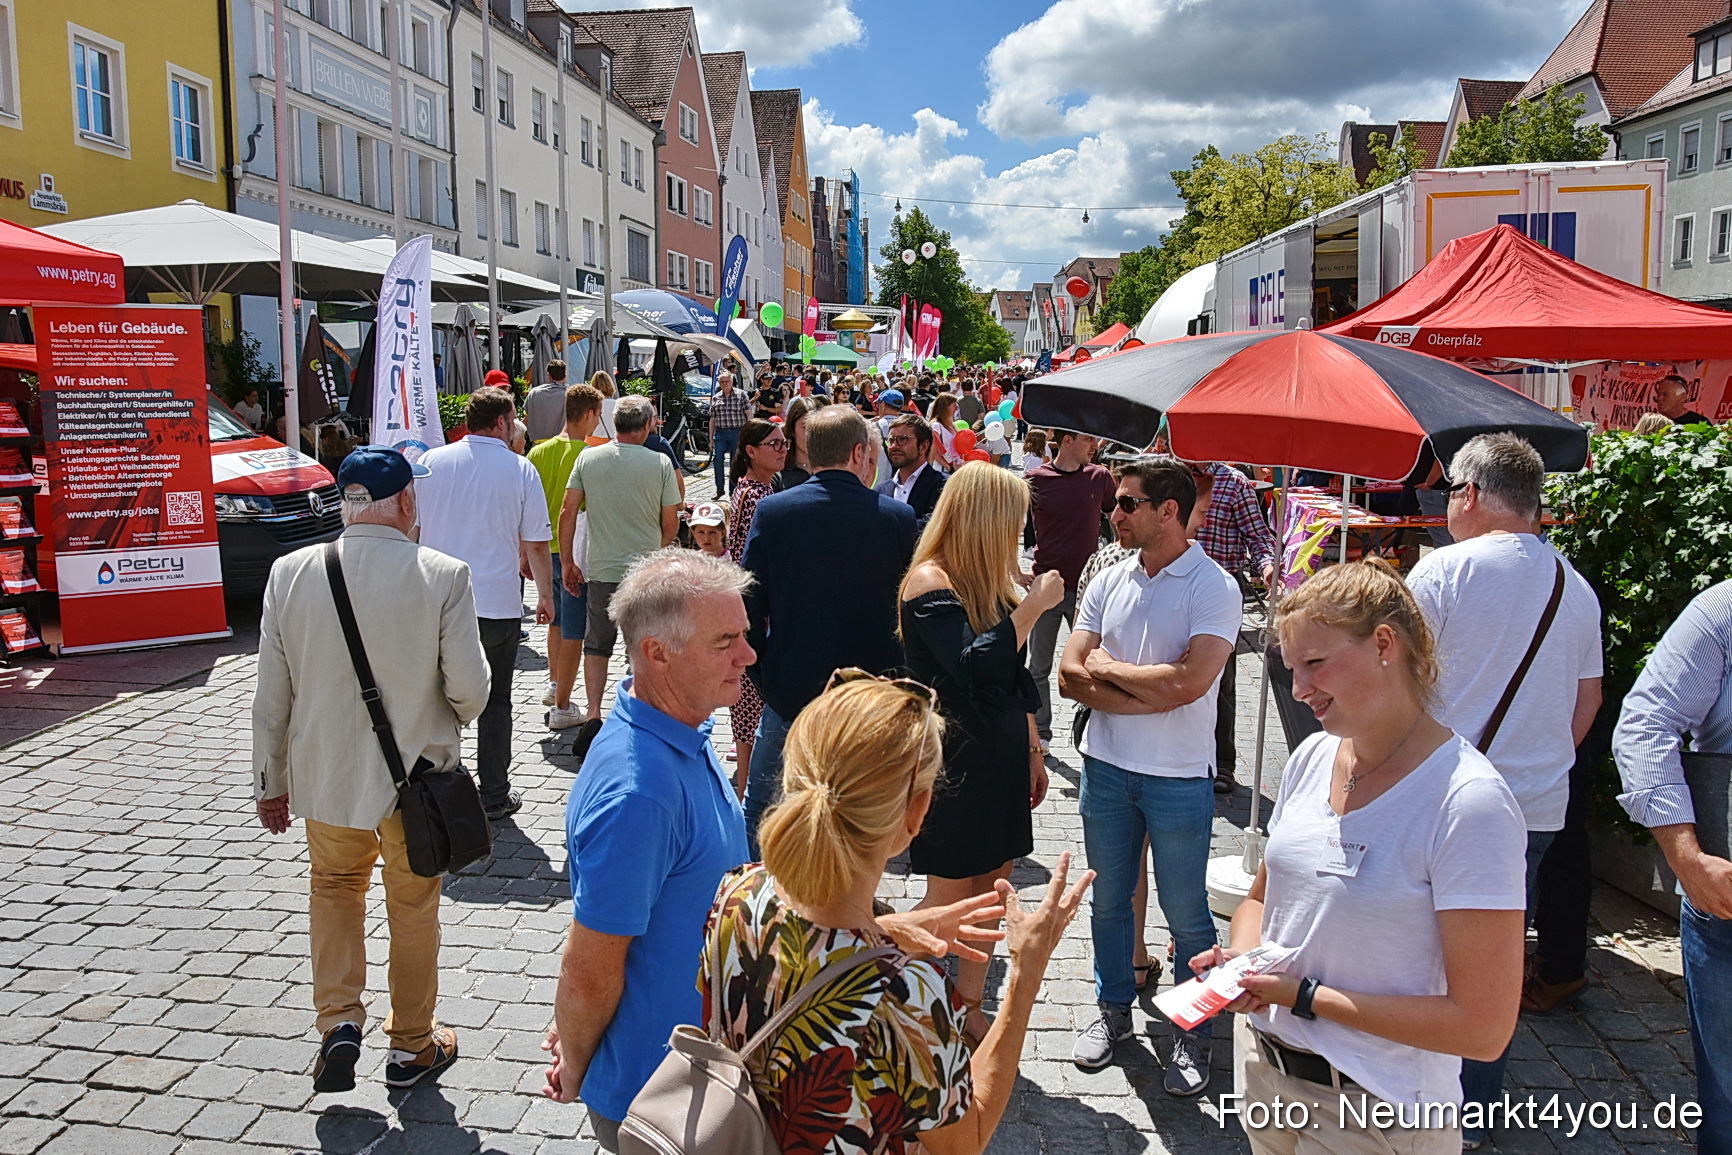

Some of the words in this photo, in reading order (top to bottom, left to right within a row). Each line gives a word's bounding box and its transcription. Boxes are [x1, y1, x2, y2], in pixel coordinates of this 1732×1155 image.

[316, 60, 360, 98] BRILLEN
[361, 79, 392, 112] WEBE
[37, 192, 62, 202] Neumarkter
[33, 198, 67, 212] Lammsbräu
[37, 265, 117, 288] www.petry.ag
[1260, 268, 1285, 325] PFLE
[50, 321, 95, 334] Leben
[98, 321, 118, 334] für
[121, 321, 188, 335] Gebäude.
[1380, 331, 1412, 344] DGB
[1427, 333, 1483, 348] Oberpfalz
[409, 327, 421, 371] KÄLTE
[54, 375, 76, 387] Wir
[79, 375, 128, 386] suchen:
[55, 391, 107, 399] Technische/r
[109, 391, 172, 399] Systemplaner/in
[413, 377, 427, 427] WÄRME
[1717, 402, 1732, 417] DG
[57, 411, 106, 420] Elektriker/in
[108, 411, 119, 419] für
[121, 411, 136, 419] den
[138, 411, 190, 419] Kundendienst
[58, 421, 143, 431] Kälteanlagenbauer/in
[59, 431, 147, 441] Anlagenmechaniker/in
[60, 447, 84, 455] Unser
[86, 446, 139, 454] Karriere-Plus:
[66, 455, 139, 464] Leistungsgerechte
[140, 453, 180, 462] Bezahlung
[119, 462, 180, 471] Weihnachtsgeld
[68, 473, 115, 482] Betriebliche
[117, 471, 173, 480] Altersvorsorge
[69, 481, 163, 491] Weiterbildungsangebote
[70, 490, 138, 500] Umzugszuschuss
[66, 506, 160, 519] www.petry.ag/jobs
[119, 576, 142, 584] WÄRME
[144, 574, 164, 582] KÄLTE
